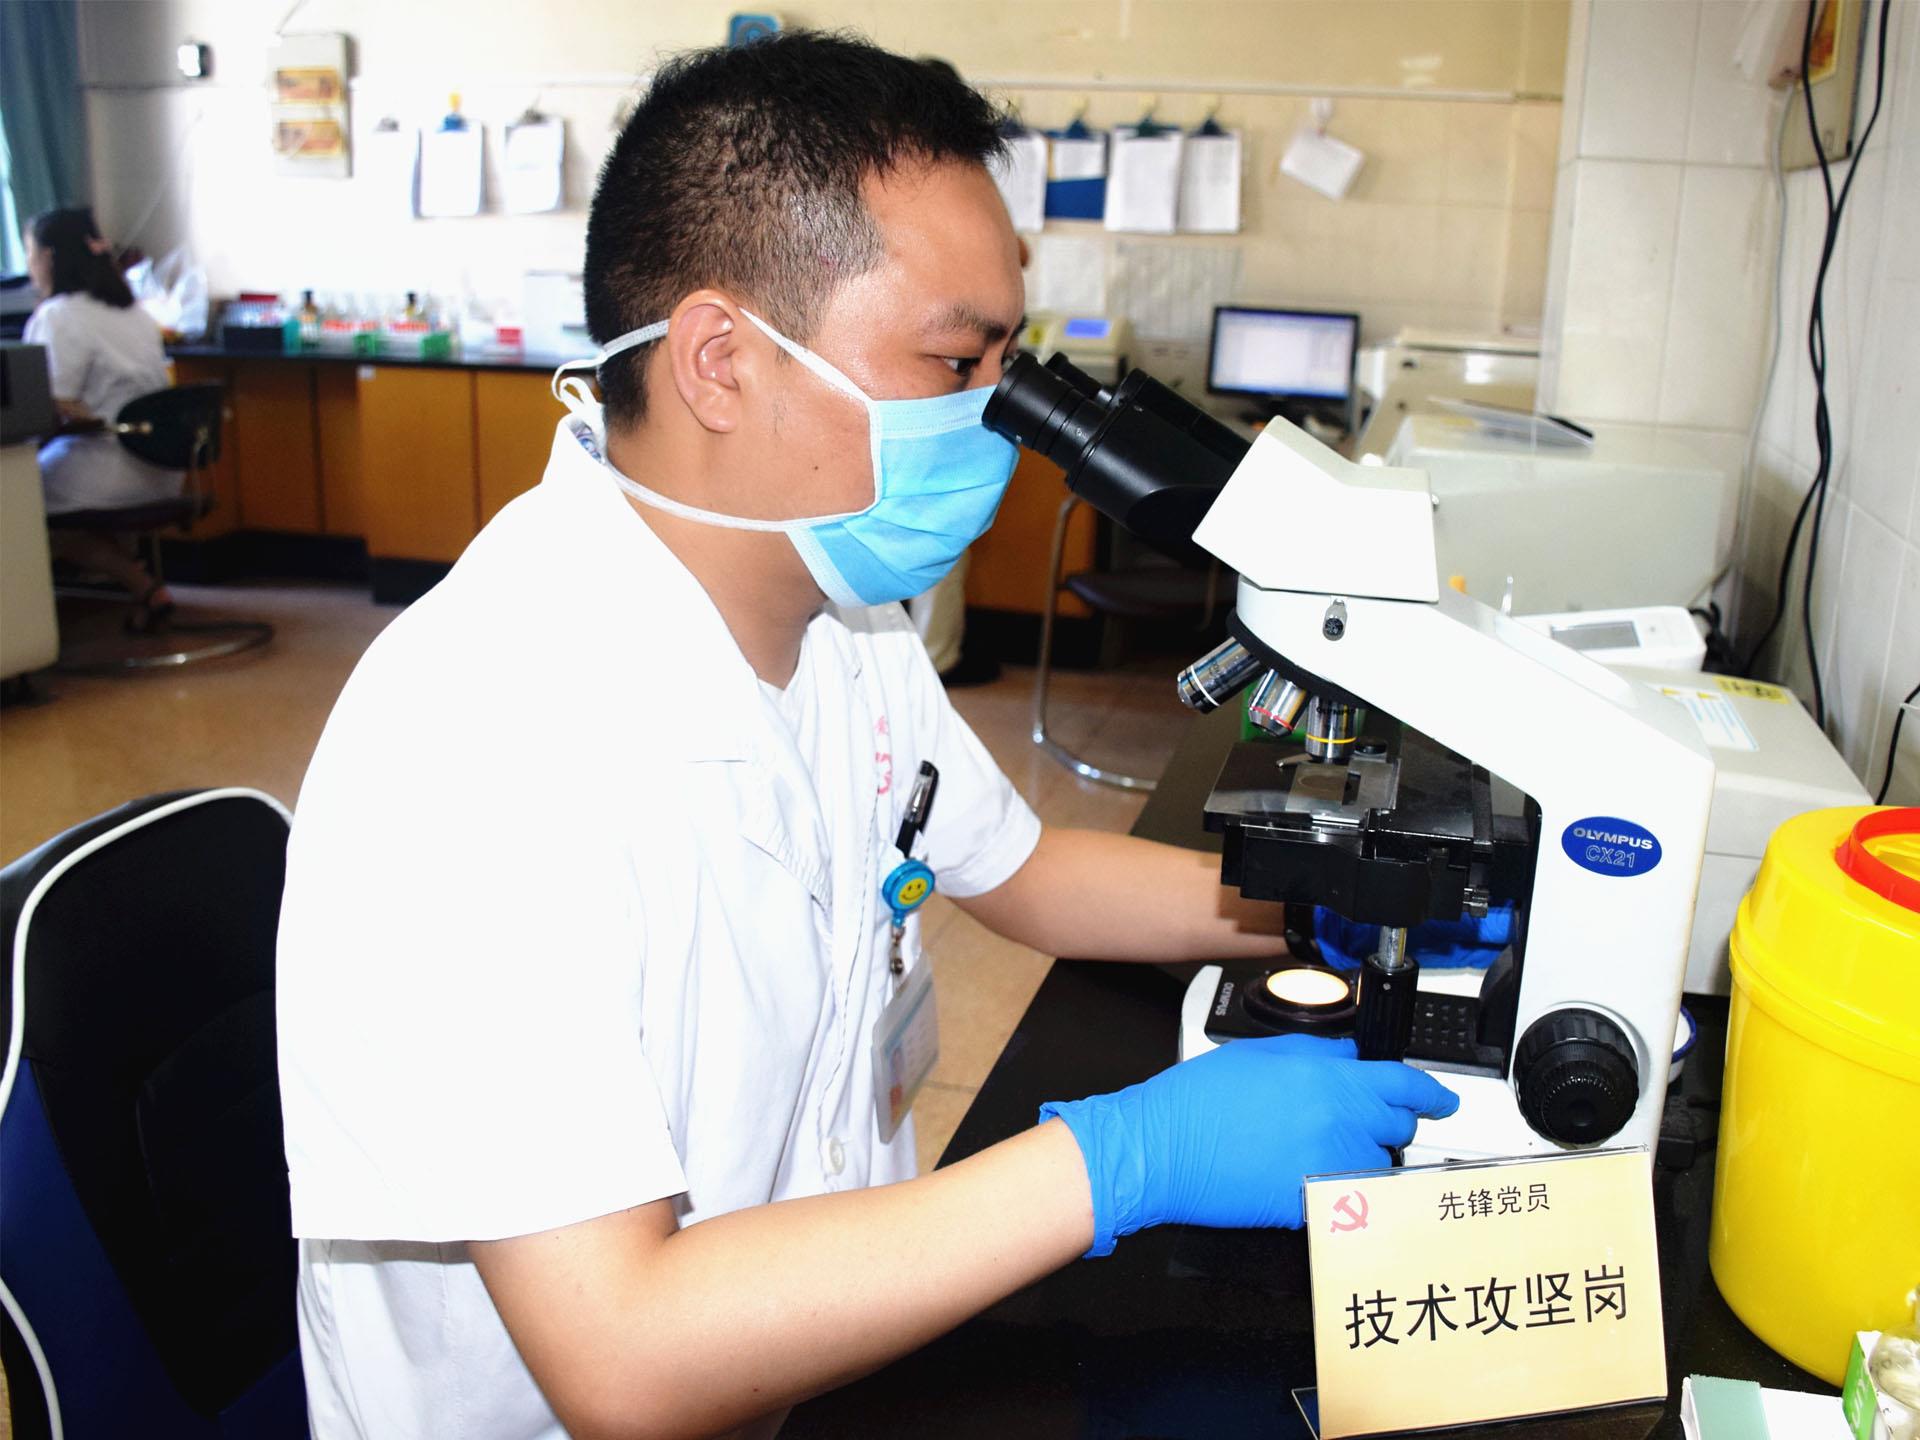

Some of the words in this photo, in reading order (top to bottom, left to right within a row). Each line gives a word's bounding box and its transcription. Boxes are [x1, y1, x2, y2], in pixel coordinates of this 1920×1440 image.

[1573, 827, 1653, 850] OLYMPUS
[1585, 844, 1635, 868] CX21
[1438, 1183, 1550, 1221] 先锋党员
[1345, 1264, 1627, 1350] 技术攻坚岗
